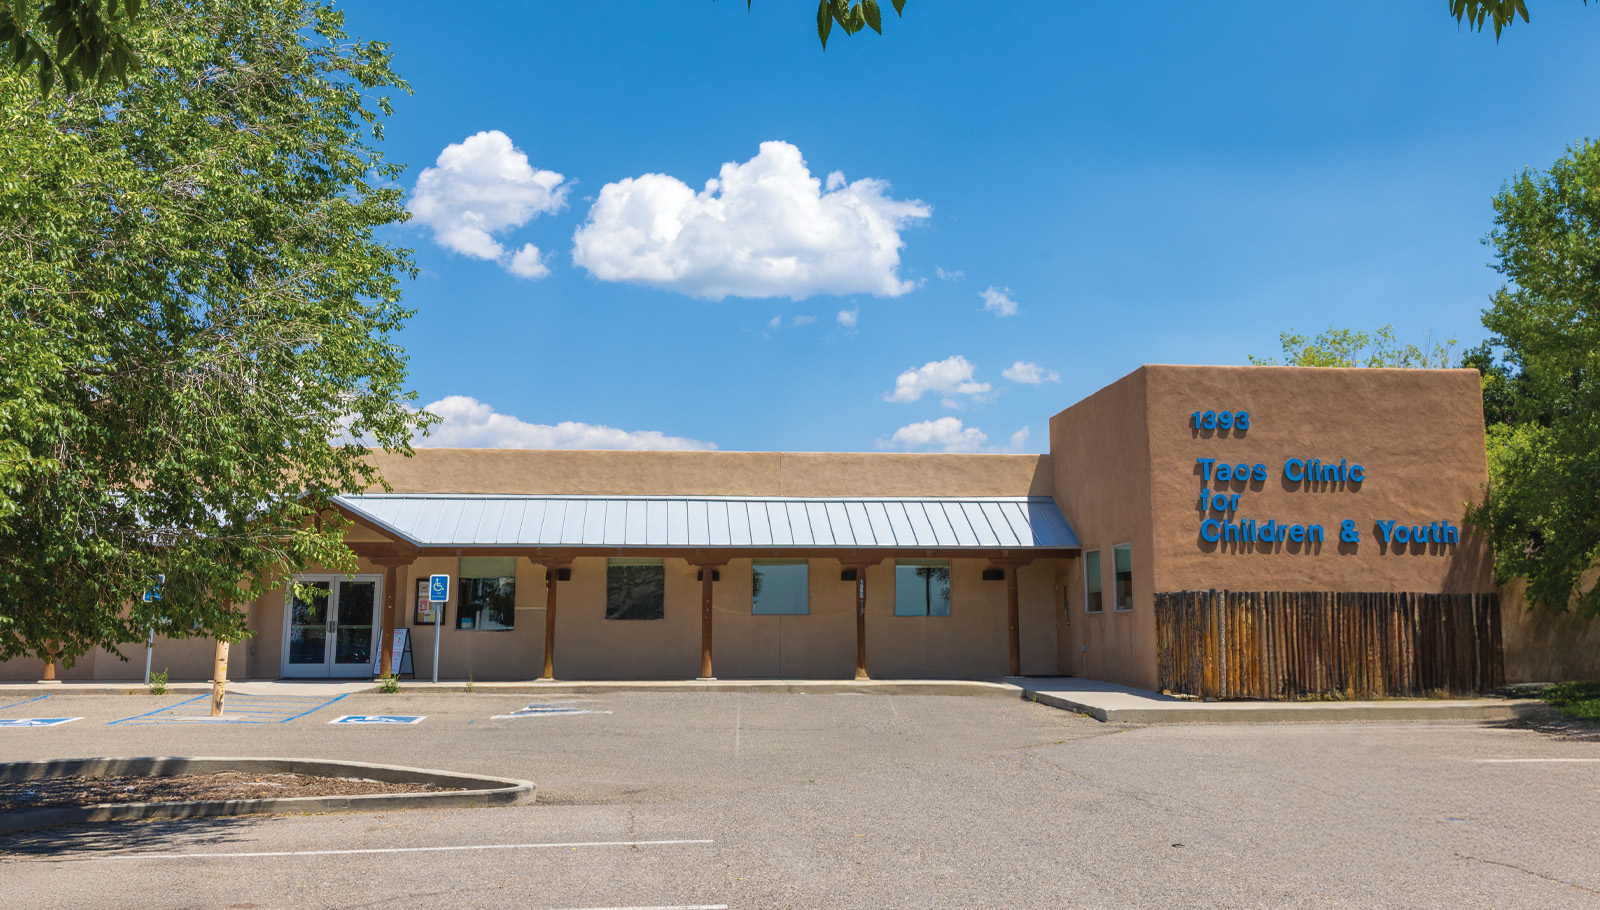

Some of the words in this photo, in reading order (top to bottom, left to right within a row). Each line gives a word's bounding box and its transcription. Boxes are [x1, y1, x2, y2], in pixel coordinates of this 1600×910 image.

[1192, 411, 1250, 430] 1393
[1197, 458, 1267, 481] Taos
[1285, 458, 1365, 482] Clinic
[1200, 488, 1240, 511] for
[1201, 519, 1324, 542] Children
[1341, 519, 1360, 543] &
[1376, 520, 1459, 544] Youth
